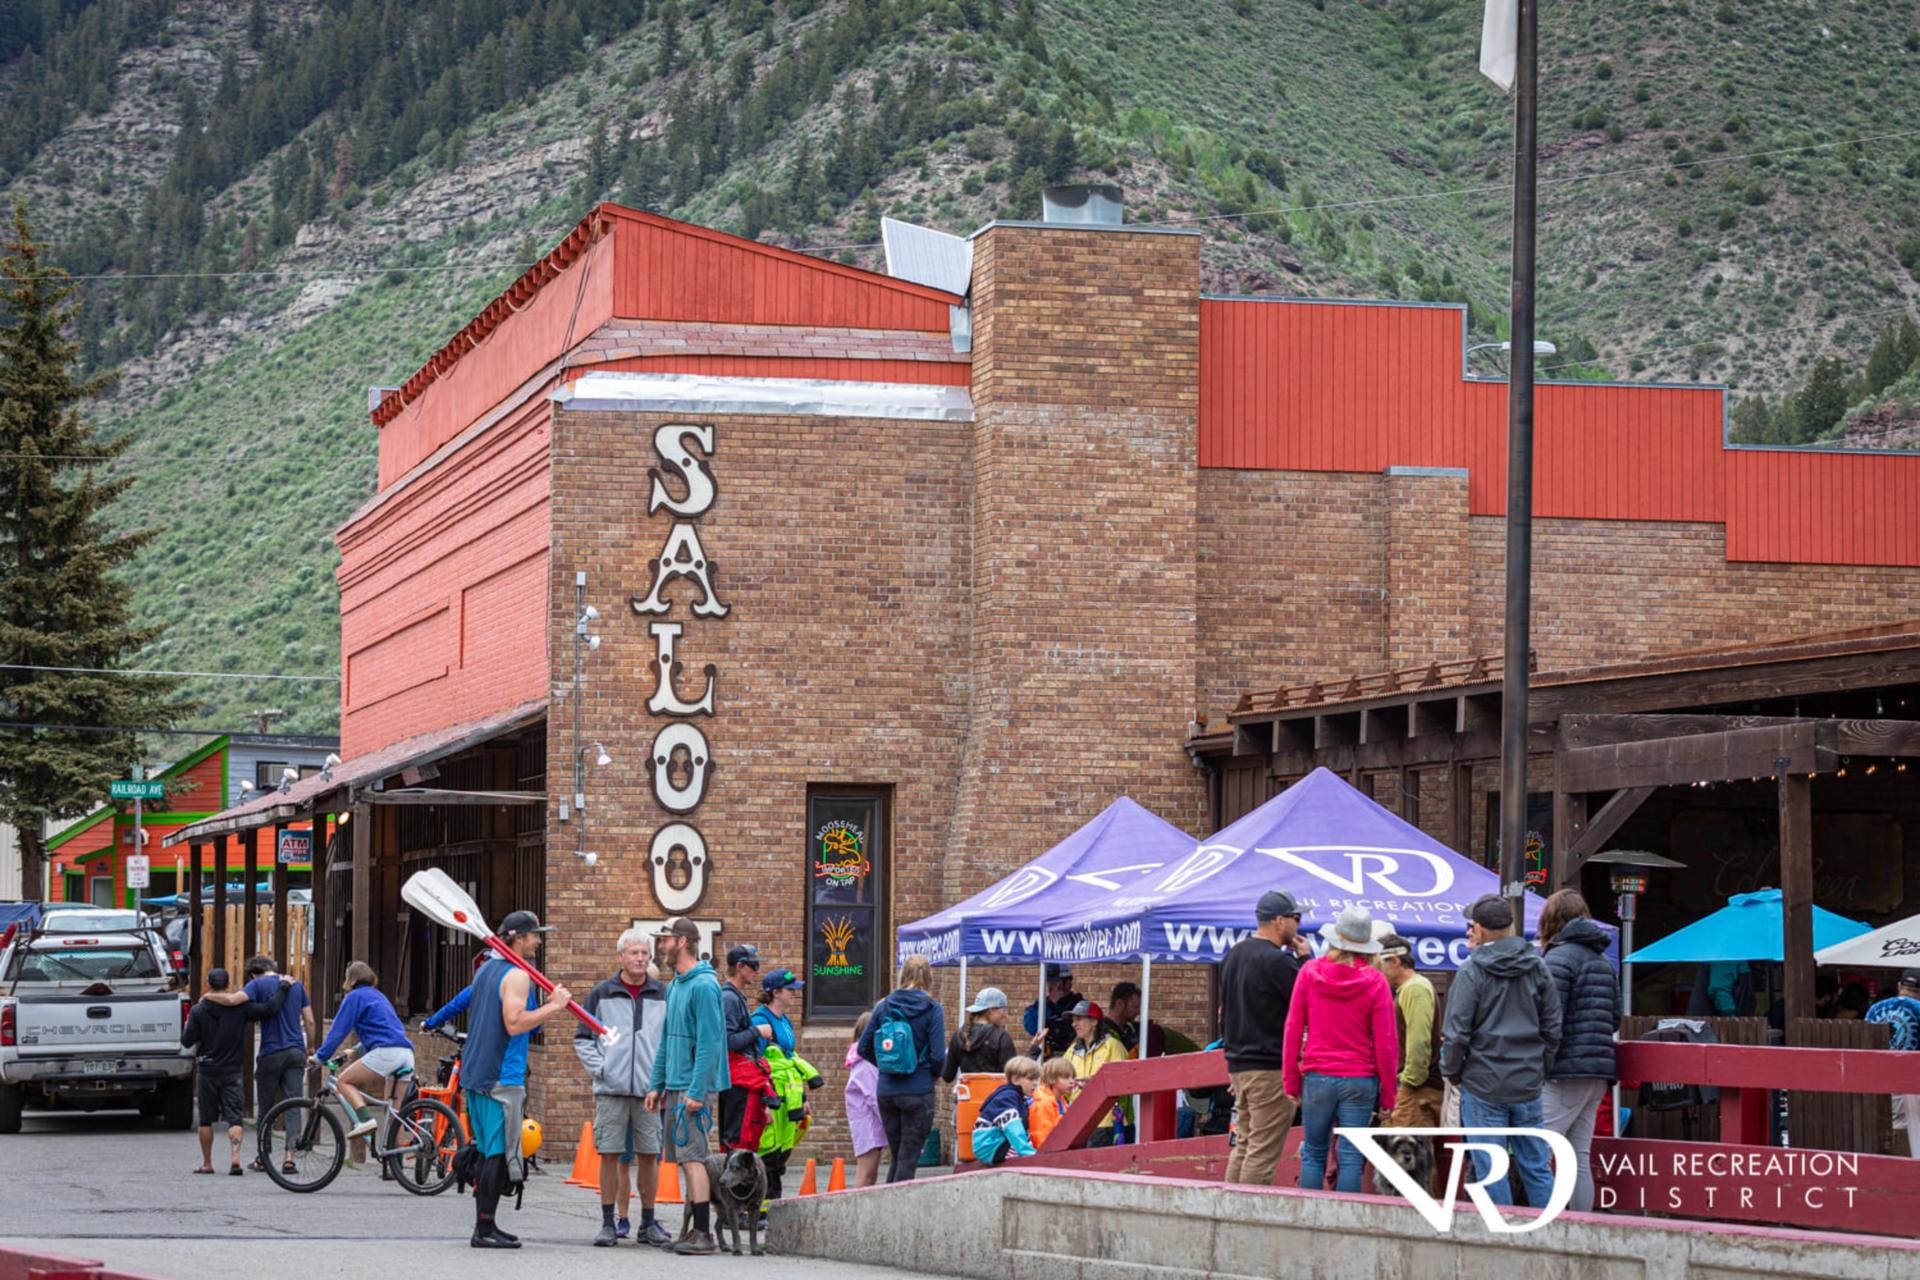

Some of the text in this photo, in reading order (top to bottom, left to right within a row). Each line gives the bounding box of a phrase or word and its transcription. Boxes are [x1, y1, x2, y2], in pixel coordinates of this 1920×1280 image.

[112, 784, 162, 794] RAILROAD AVE
[815, 820, 864, 843] MOOSEHEA
[283, 838, 308, 849] ATM
[825, 876, 856, 887] ON TAP
[1043, 921, 1141, 960] www.vailrec.com
[814, 963, 863, 976] SUNSHINE
[26, 1022, 172, 1036] CHEVROLET
